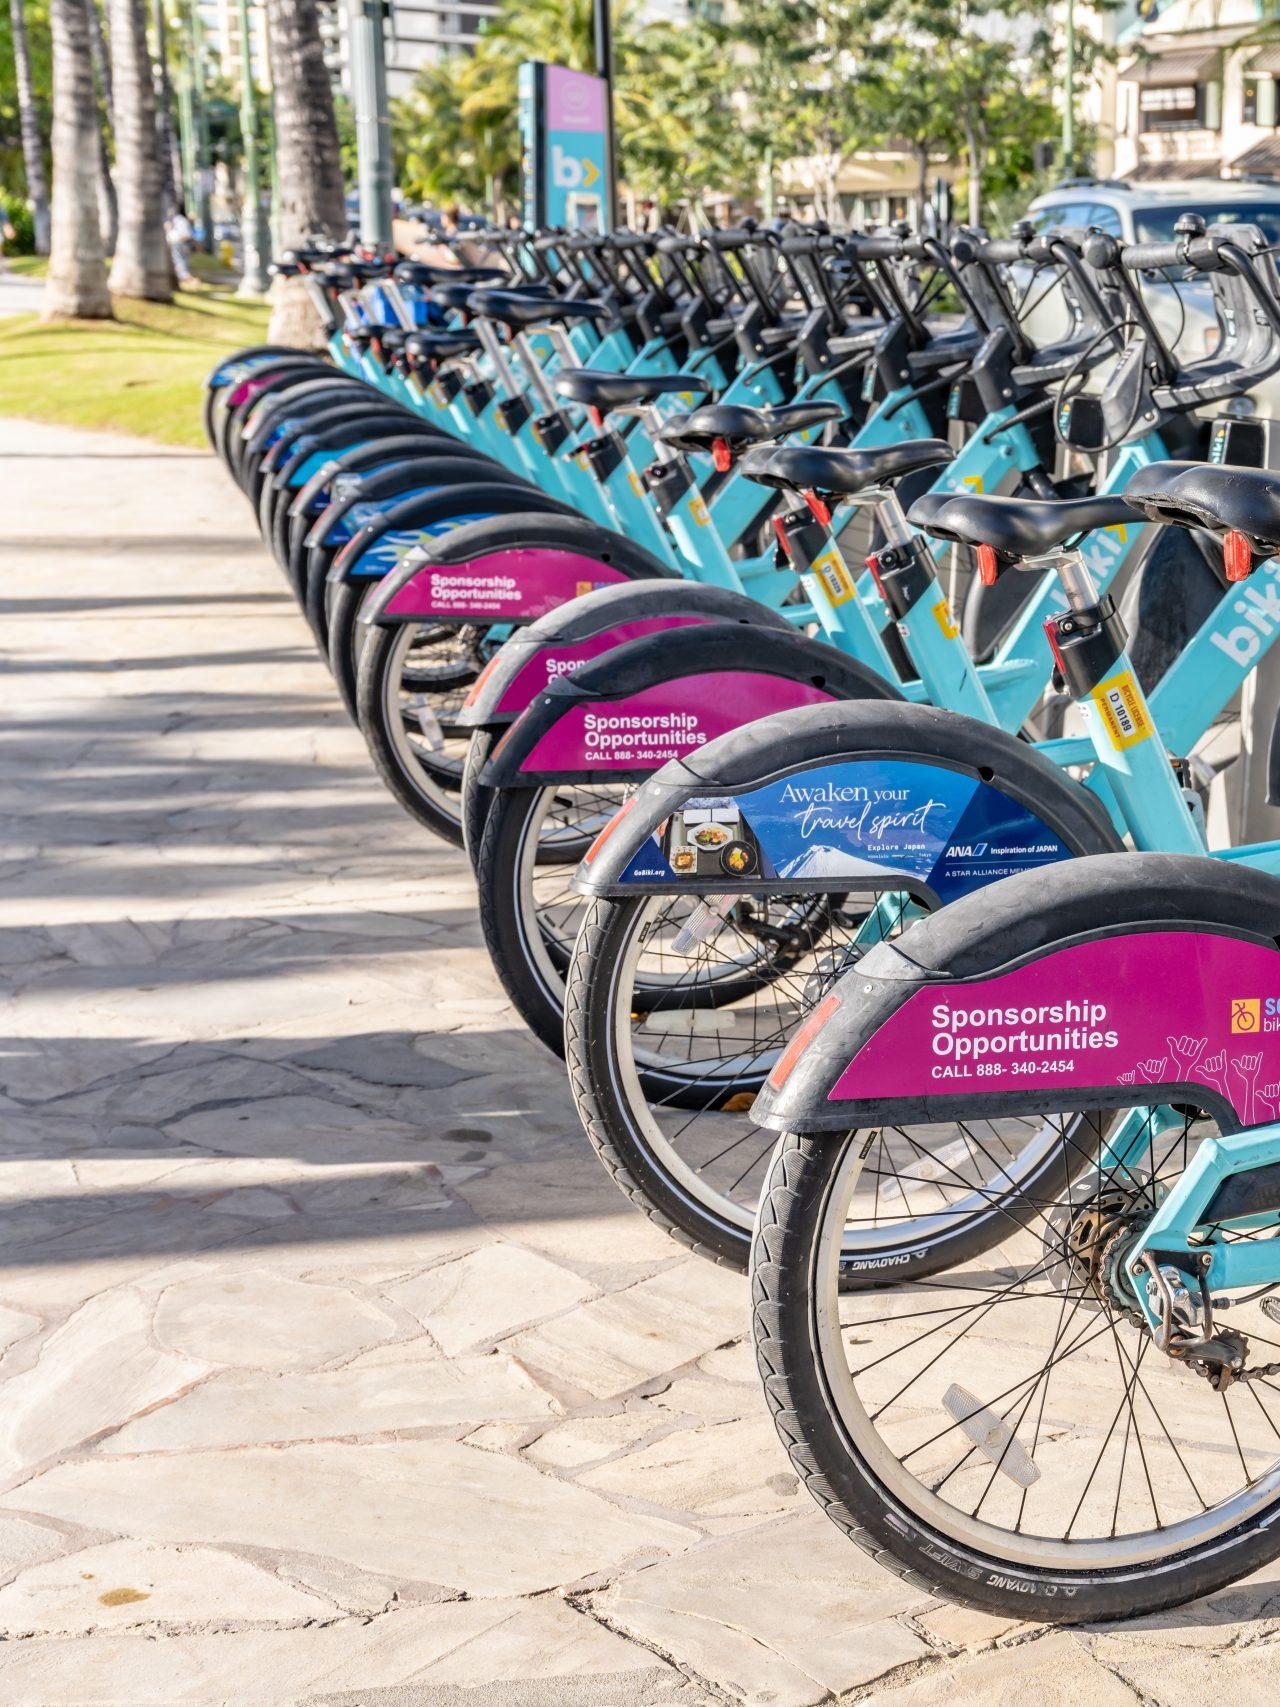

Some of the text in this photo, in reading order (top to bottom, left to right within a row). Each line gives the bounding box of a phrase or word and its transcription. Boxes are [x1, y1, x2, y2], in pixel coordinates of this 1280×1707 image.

[431, 574, 515, 589] Sponsorship
[431, 586, 522, 600] Opportunities
[1100, 698, 1121, 738] PERMANENT
[1109, 692, 1132, 732] D 10189
[584, 713, 697, 732] Sponsorship
[584, 730, 707, 749] Opportunities
[585, 752, 611, 760] CALL
[637, 750, 678, 759] 340-2454
[779, 782, 910, 805] Awaken your
[794, 799, 947, 840] travel spirit
[903, 843, 926, 851] Japan
[945, 845, 973, 858] ANA
[990, 844, 1058, 856] Inspiration of JAPAN
[952, 869, 971, 877] STAR
[972, 868, 1008, 876] ALLIANCE
[931, 999, 1106, 1035] Sponsorship
[931, 1027, 1119, 1060] Opportunities
[931, 1060, 1075, 1079] CALL 888- 340-2454
[853, 1254, 911, 1271] CHAOYANG
